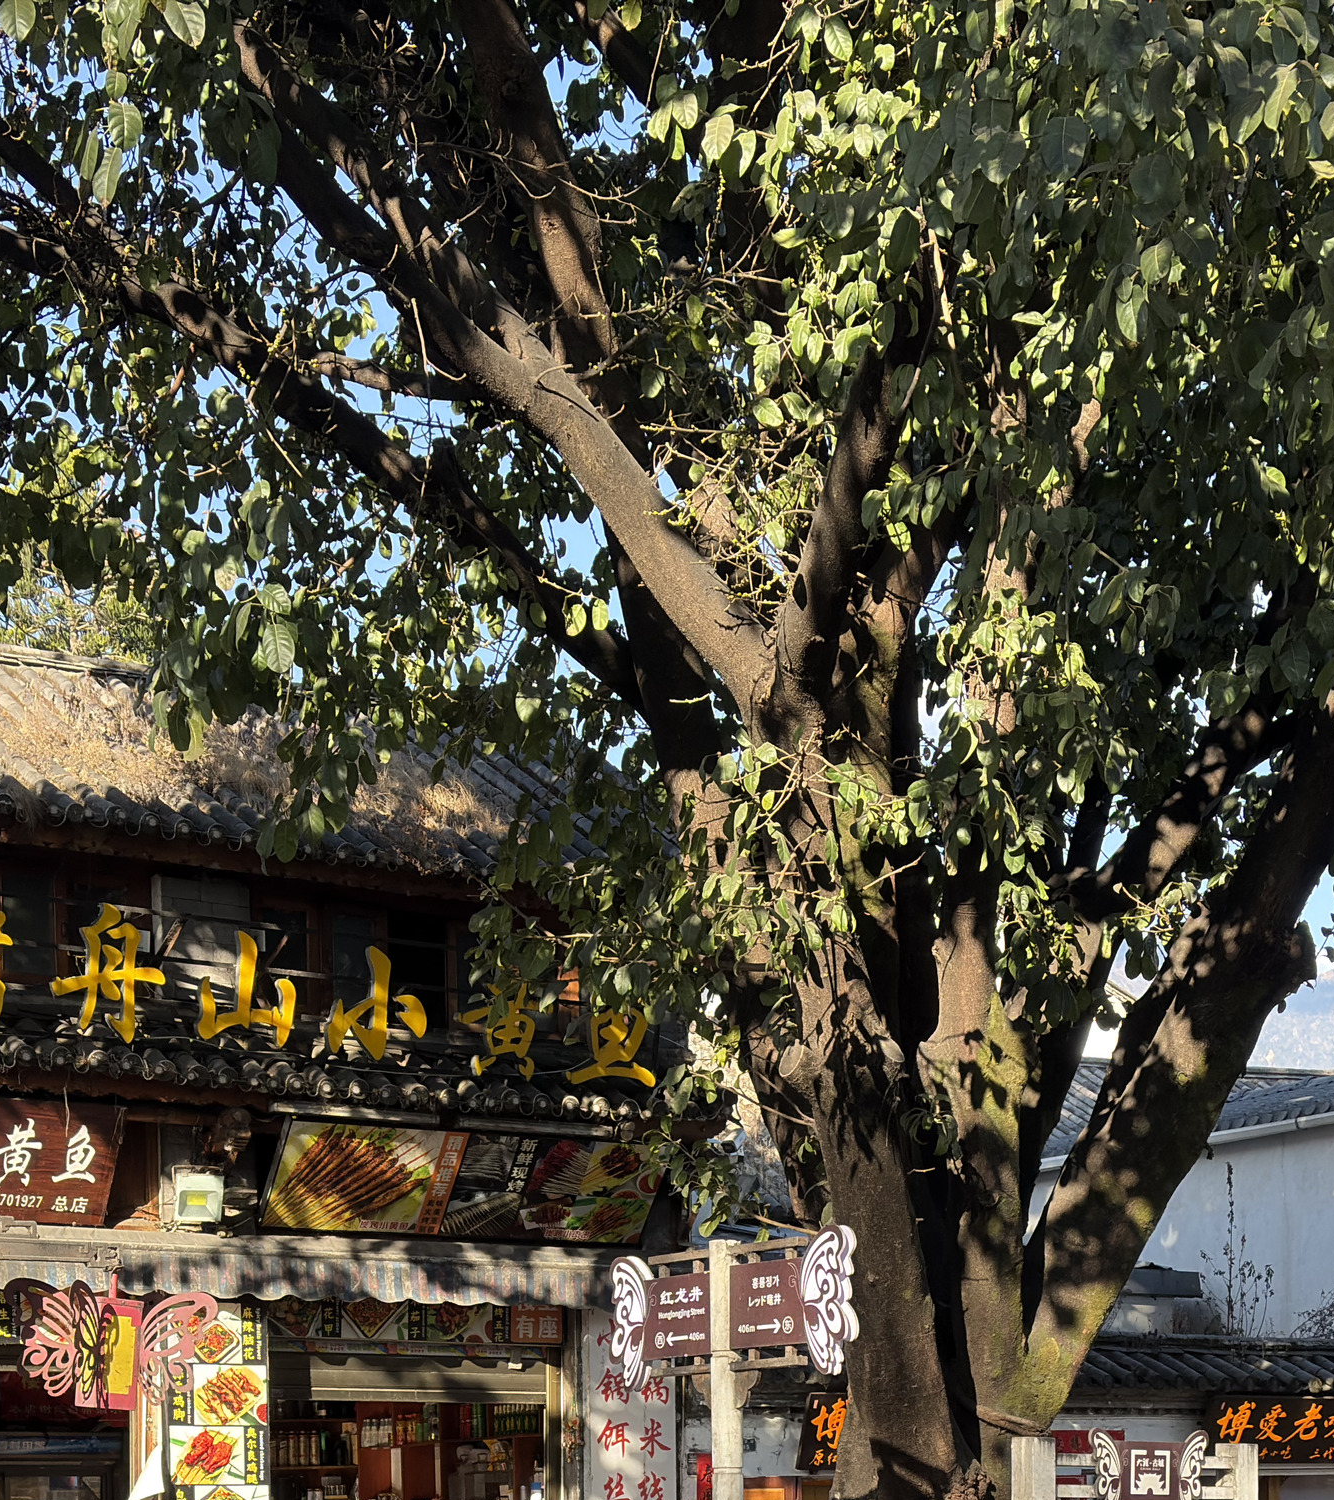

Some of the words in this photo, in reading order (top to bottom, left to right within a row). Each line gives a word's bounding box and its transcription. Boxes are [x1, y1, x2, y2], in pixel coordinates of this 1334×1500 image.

[431, 1135, 465, 1198] 精品推荐
[506, 1139, 540, 1193] 新鲜现烤
[51, 1196, 89, 1214] 总店
[659, 1286, 704, 1306] 红龙井
[690, 1307, 706, 1317] Street
[242, 1306, 255, 1361] 麻辣脑花
[516, 1315, 560, 1340] 有座
[688, 1332, 706, 1342] 406m
[738, 1323, 756, 1334] 406m
